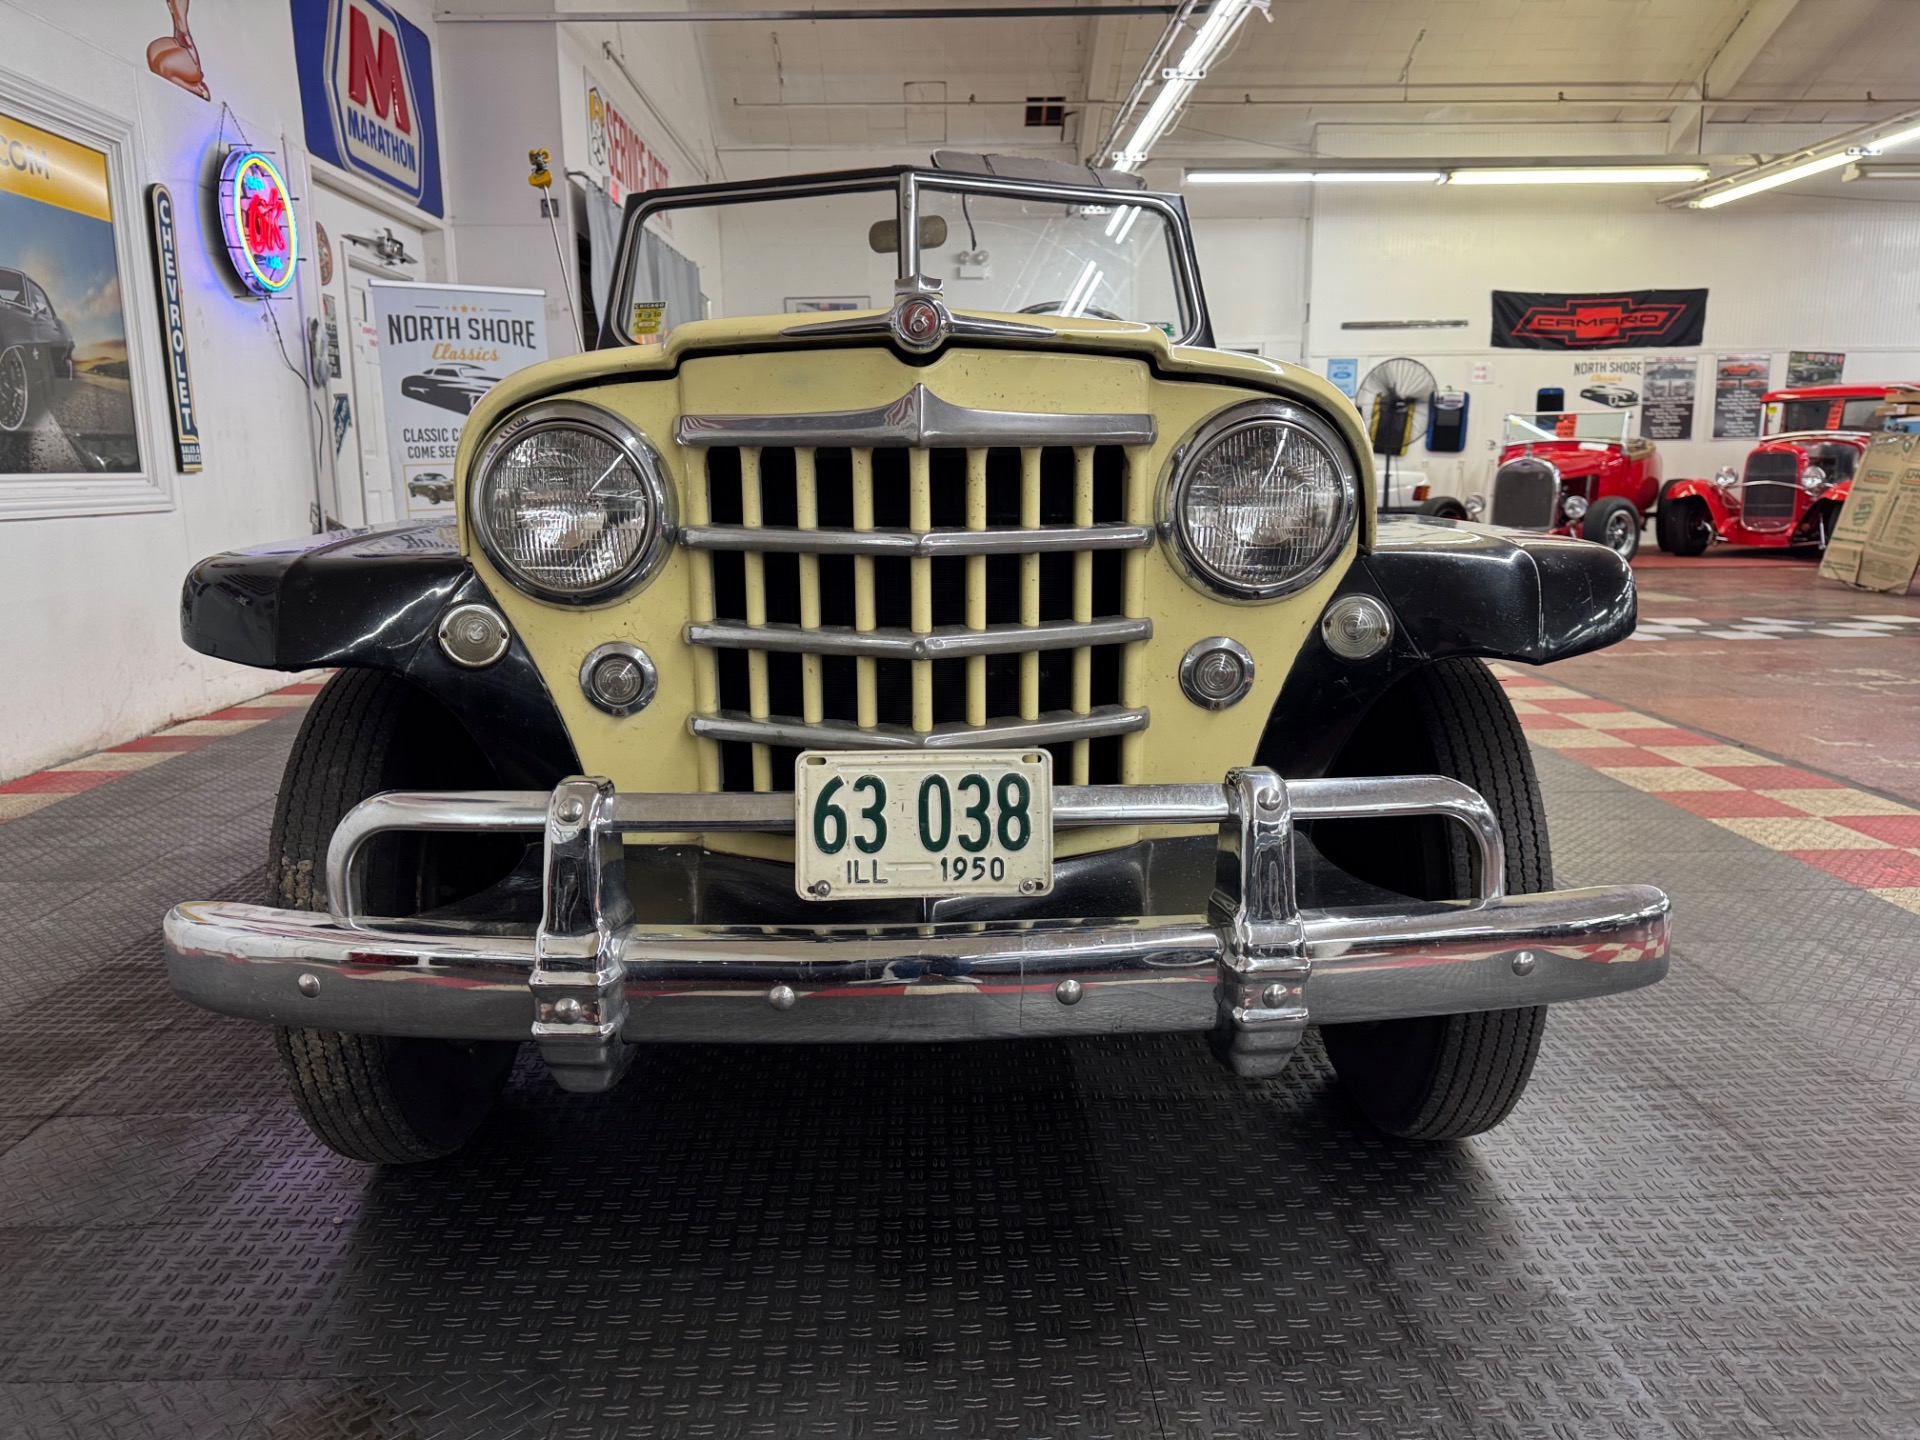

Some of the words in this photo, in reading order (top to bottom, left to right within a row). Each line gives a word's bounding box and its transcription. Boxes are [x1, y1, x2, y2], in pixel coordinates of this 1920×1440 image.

[349, 4, 411, 136] M
[347, 106, 416, 173] MARATHON
[606, 101, 646, 193] SERVICE
[249, 187, 286, 254] OK
[160, 200, 191, 430] CHEVROLET
[388, 314, 461, 346] NORTH
[467, 318, 537, 350] SHORE
[1537, 314, 1659, 328] CAMARO
[431, 342, 500, 362] Classics
[1574, 362, 1607, 376] NORTH
[1609, 361, 1643, 375] SHORE
[403, 428, 449, 443] CLASSIC
[407, 446, 436, 459] COME
[438, 446, 456, 459] SEE
[813, 774, 888, 855] 63
[917, 772, 1031, 853] 038
[847, 859, 889, 884] ILL
[940, 857, 1005, 882] 1950
